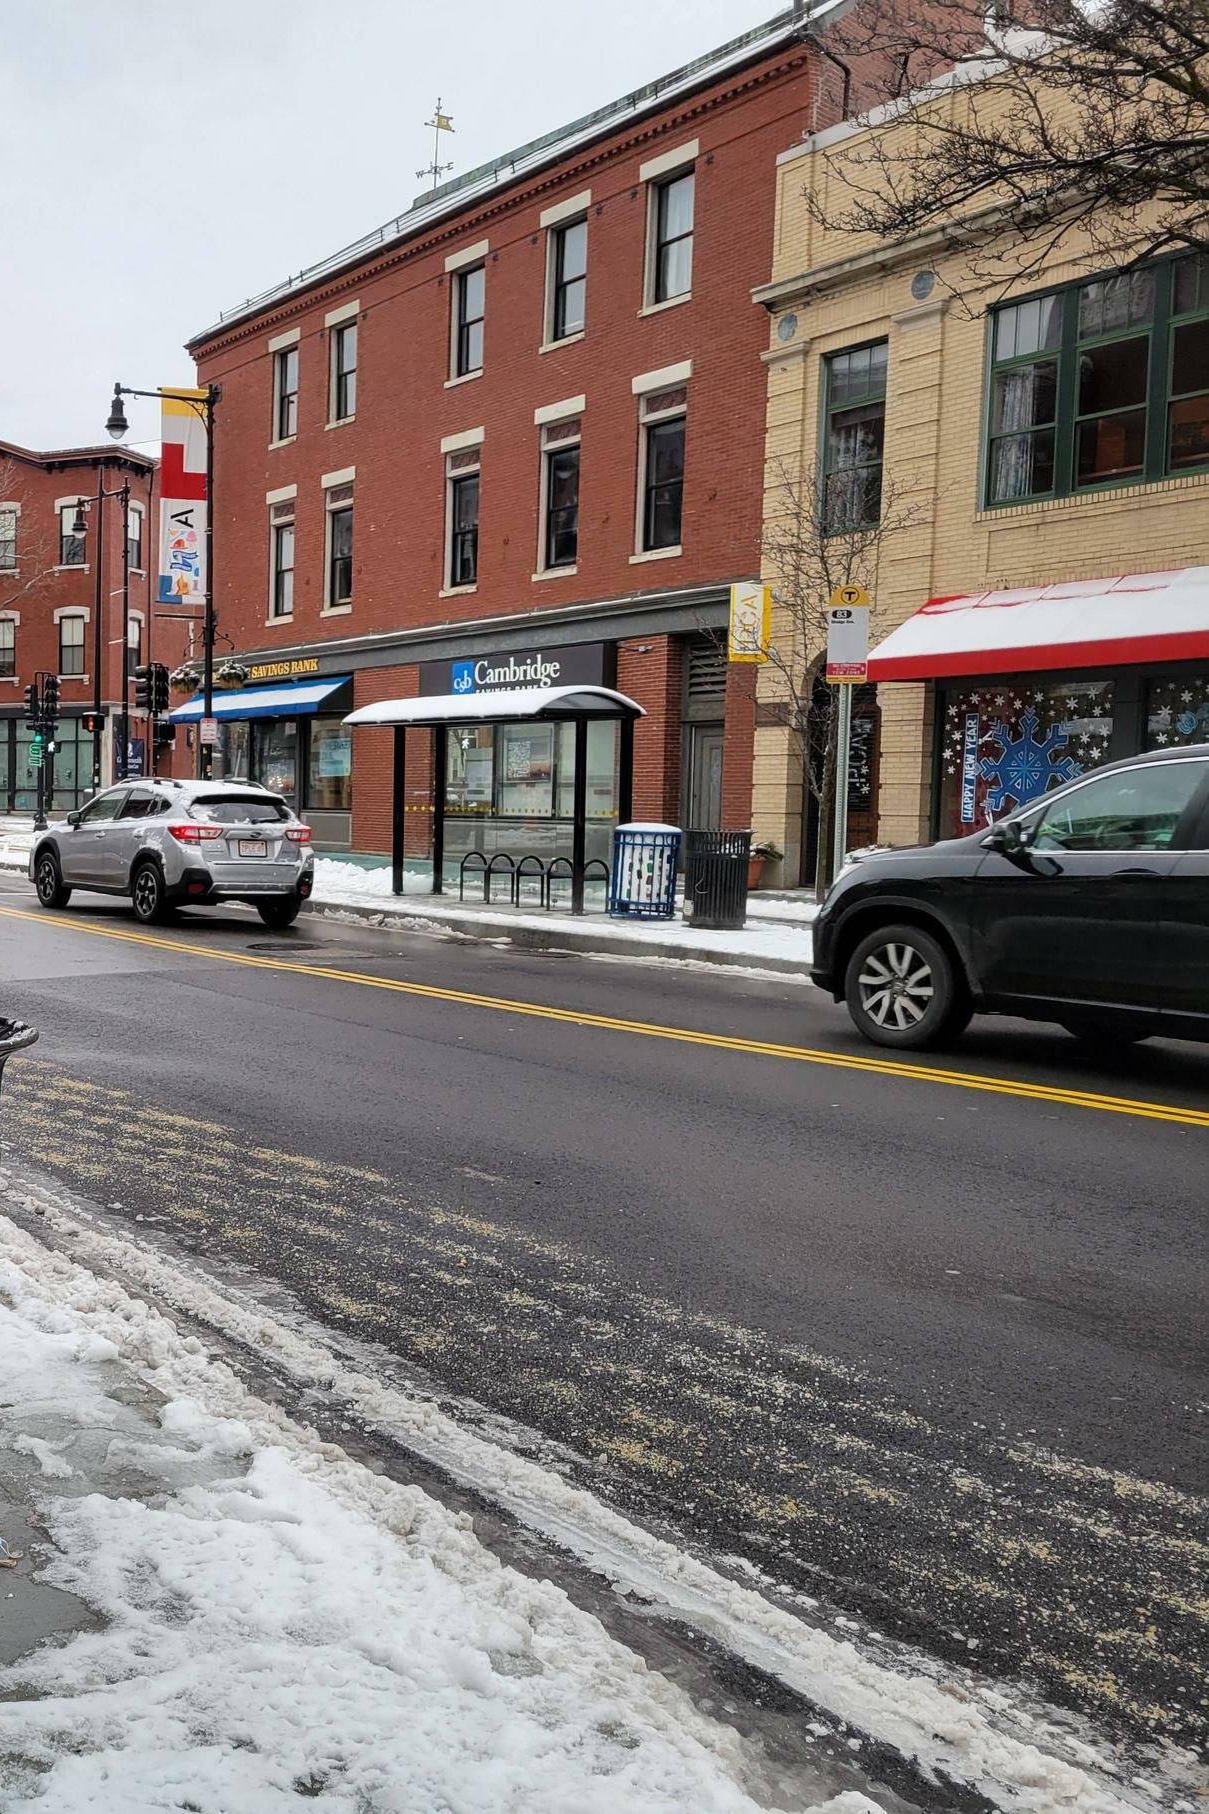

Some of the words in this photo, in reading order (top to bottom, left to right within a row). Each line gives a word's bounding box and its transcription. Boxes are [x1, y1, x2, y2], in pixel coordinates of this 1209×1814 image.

[836, 610, 847, 619] 83
[251, 661, 290, 679] SAVINGS
[291, 658, 318, 673] BANK
[454, 670, 472, 692] csb
[474, 654, 560, 688] Cambridge
[966, 719, 977, 749] YEAR
[964, 753, 976, 779] NEW
[963, 783, 974, 818] HAPPY
